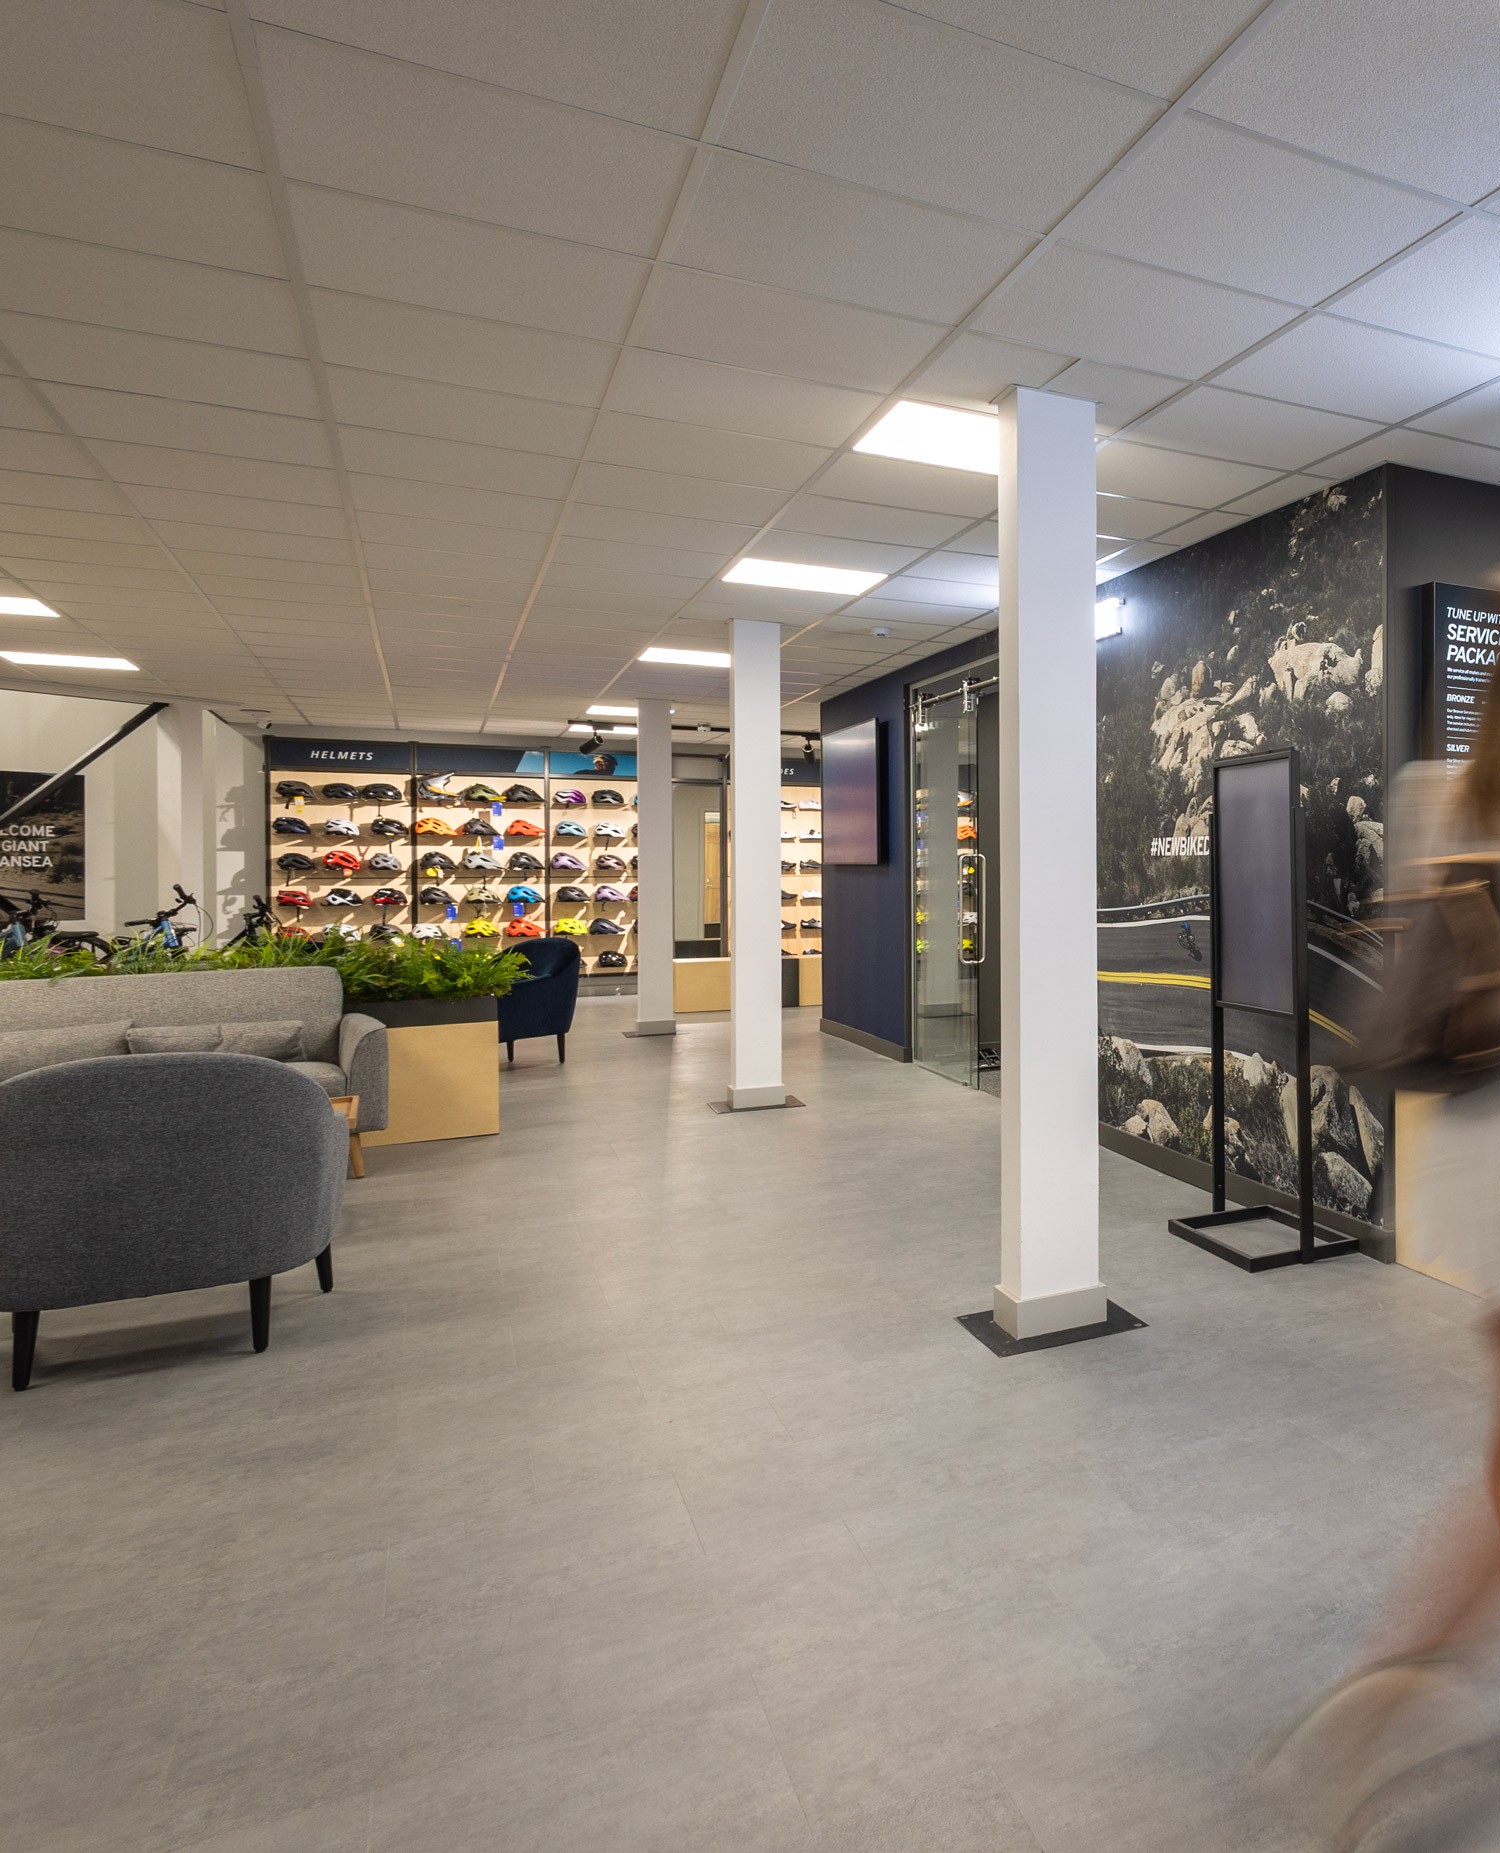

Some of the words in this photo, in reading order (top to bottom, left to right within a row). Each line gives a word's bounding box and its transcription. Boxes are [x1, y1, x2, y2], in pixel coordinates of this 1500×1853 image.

[1446, 606, 1473, 621] TUNE
[1473, 610, 1487, 623] UP
[1446, 693, 1475, 704] BRONZE
[1446, 743, 1470, 753] SILVER
[310, 750, 374, 761] HELMETS
[1, 840, 49, 852] GIANT
